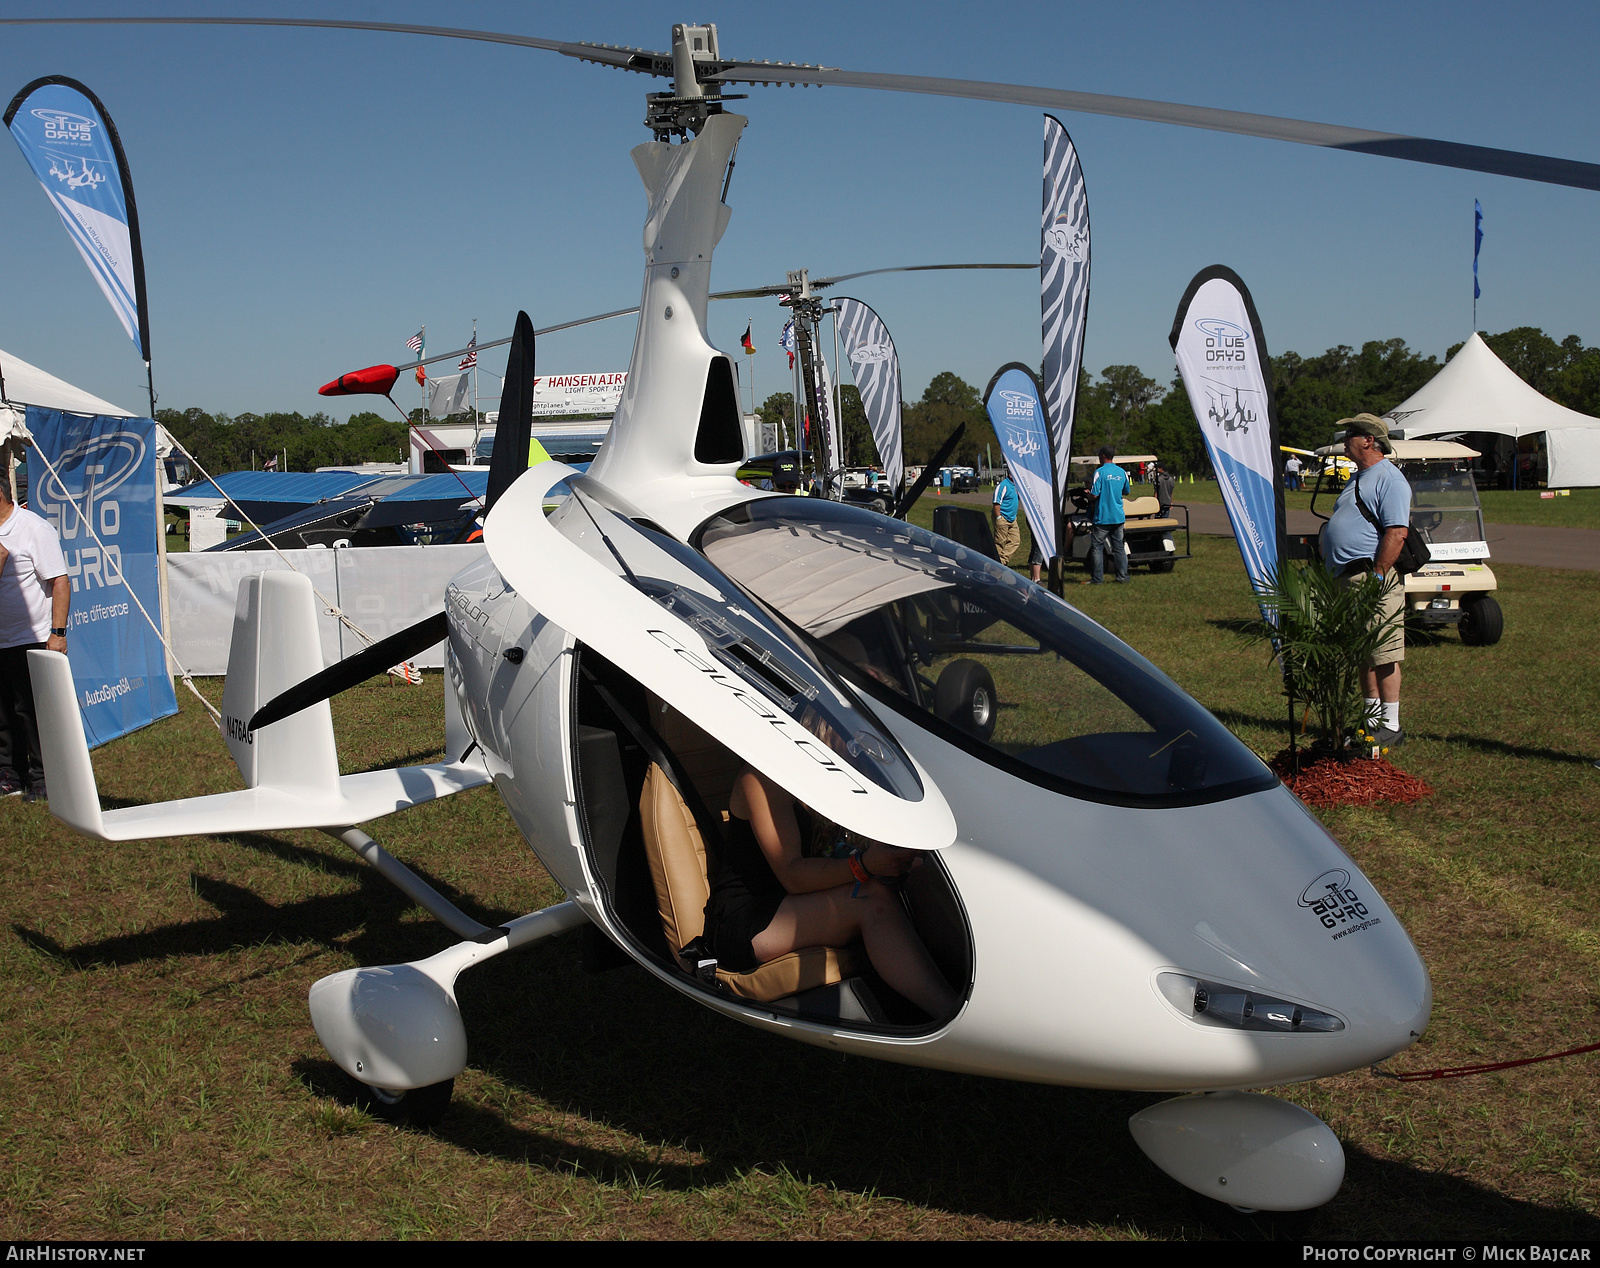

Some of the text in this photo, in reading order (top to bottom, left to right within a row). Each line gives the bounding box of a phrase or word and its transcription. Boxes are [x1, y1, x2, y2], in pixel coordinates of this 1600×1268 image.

[548, 375, 599, 388] HANSEN
[1454, 547, 1469, 555] help
[1471, 545, 1487, 554] you?
[64, 544, 123, 593] YRO
[74, 608, 89, 626] the
[89, 602, 129, 622] difference
[226, 715, 254, 745] N476AG
[1319, 902, 1369, 929] GYRO
[1331, 917, 1382, 941] www.auto-gyro.com
